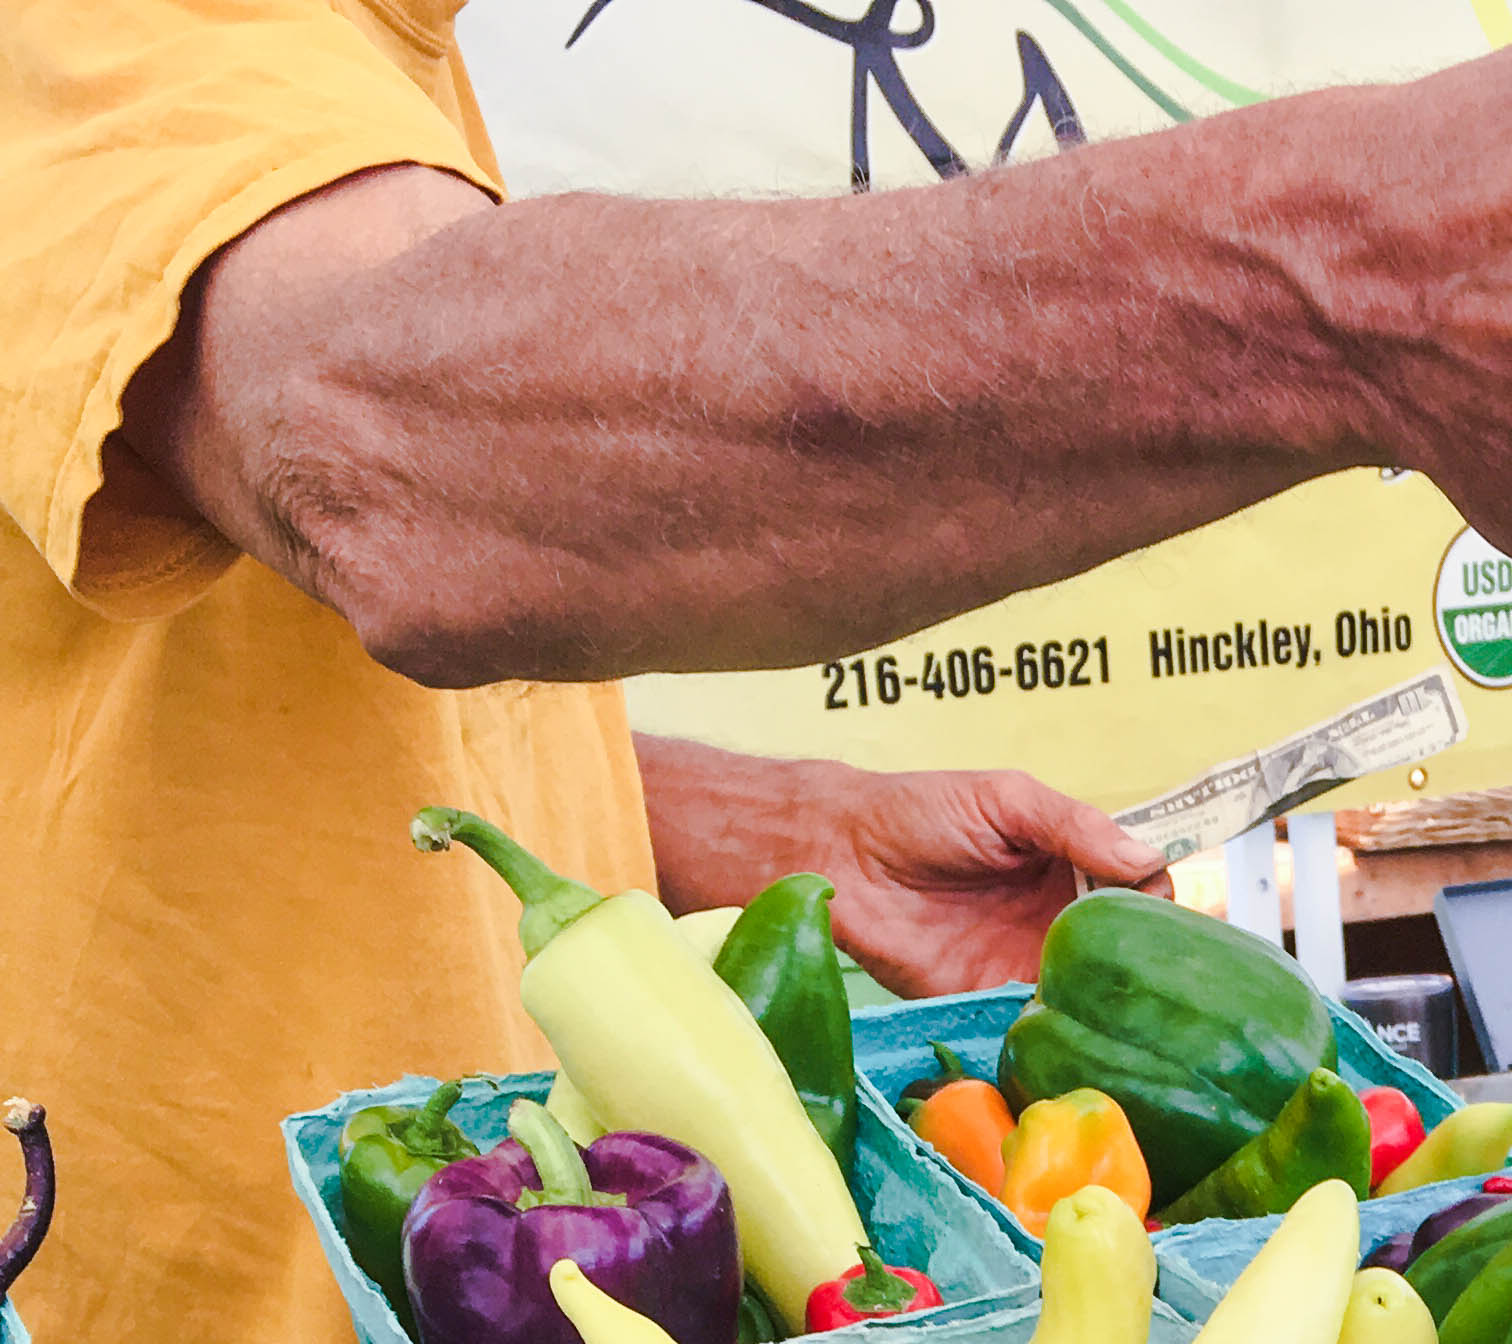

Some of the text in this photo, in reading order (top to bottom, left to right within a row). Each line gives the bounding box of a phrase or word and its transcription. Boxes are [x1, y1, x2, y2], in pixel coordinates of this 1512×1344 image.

[822, 607, 1412, 710] 216-406-6621 Hinckley, Ohio
